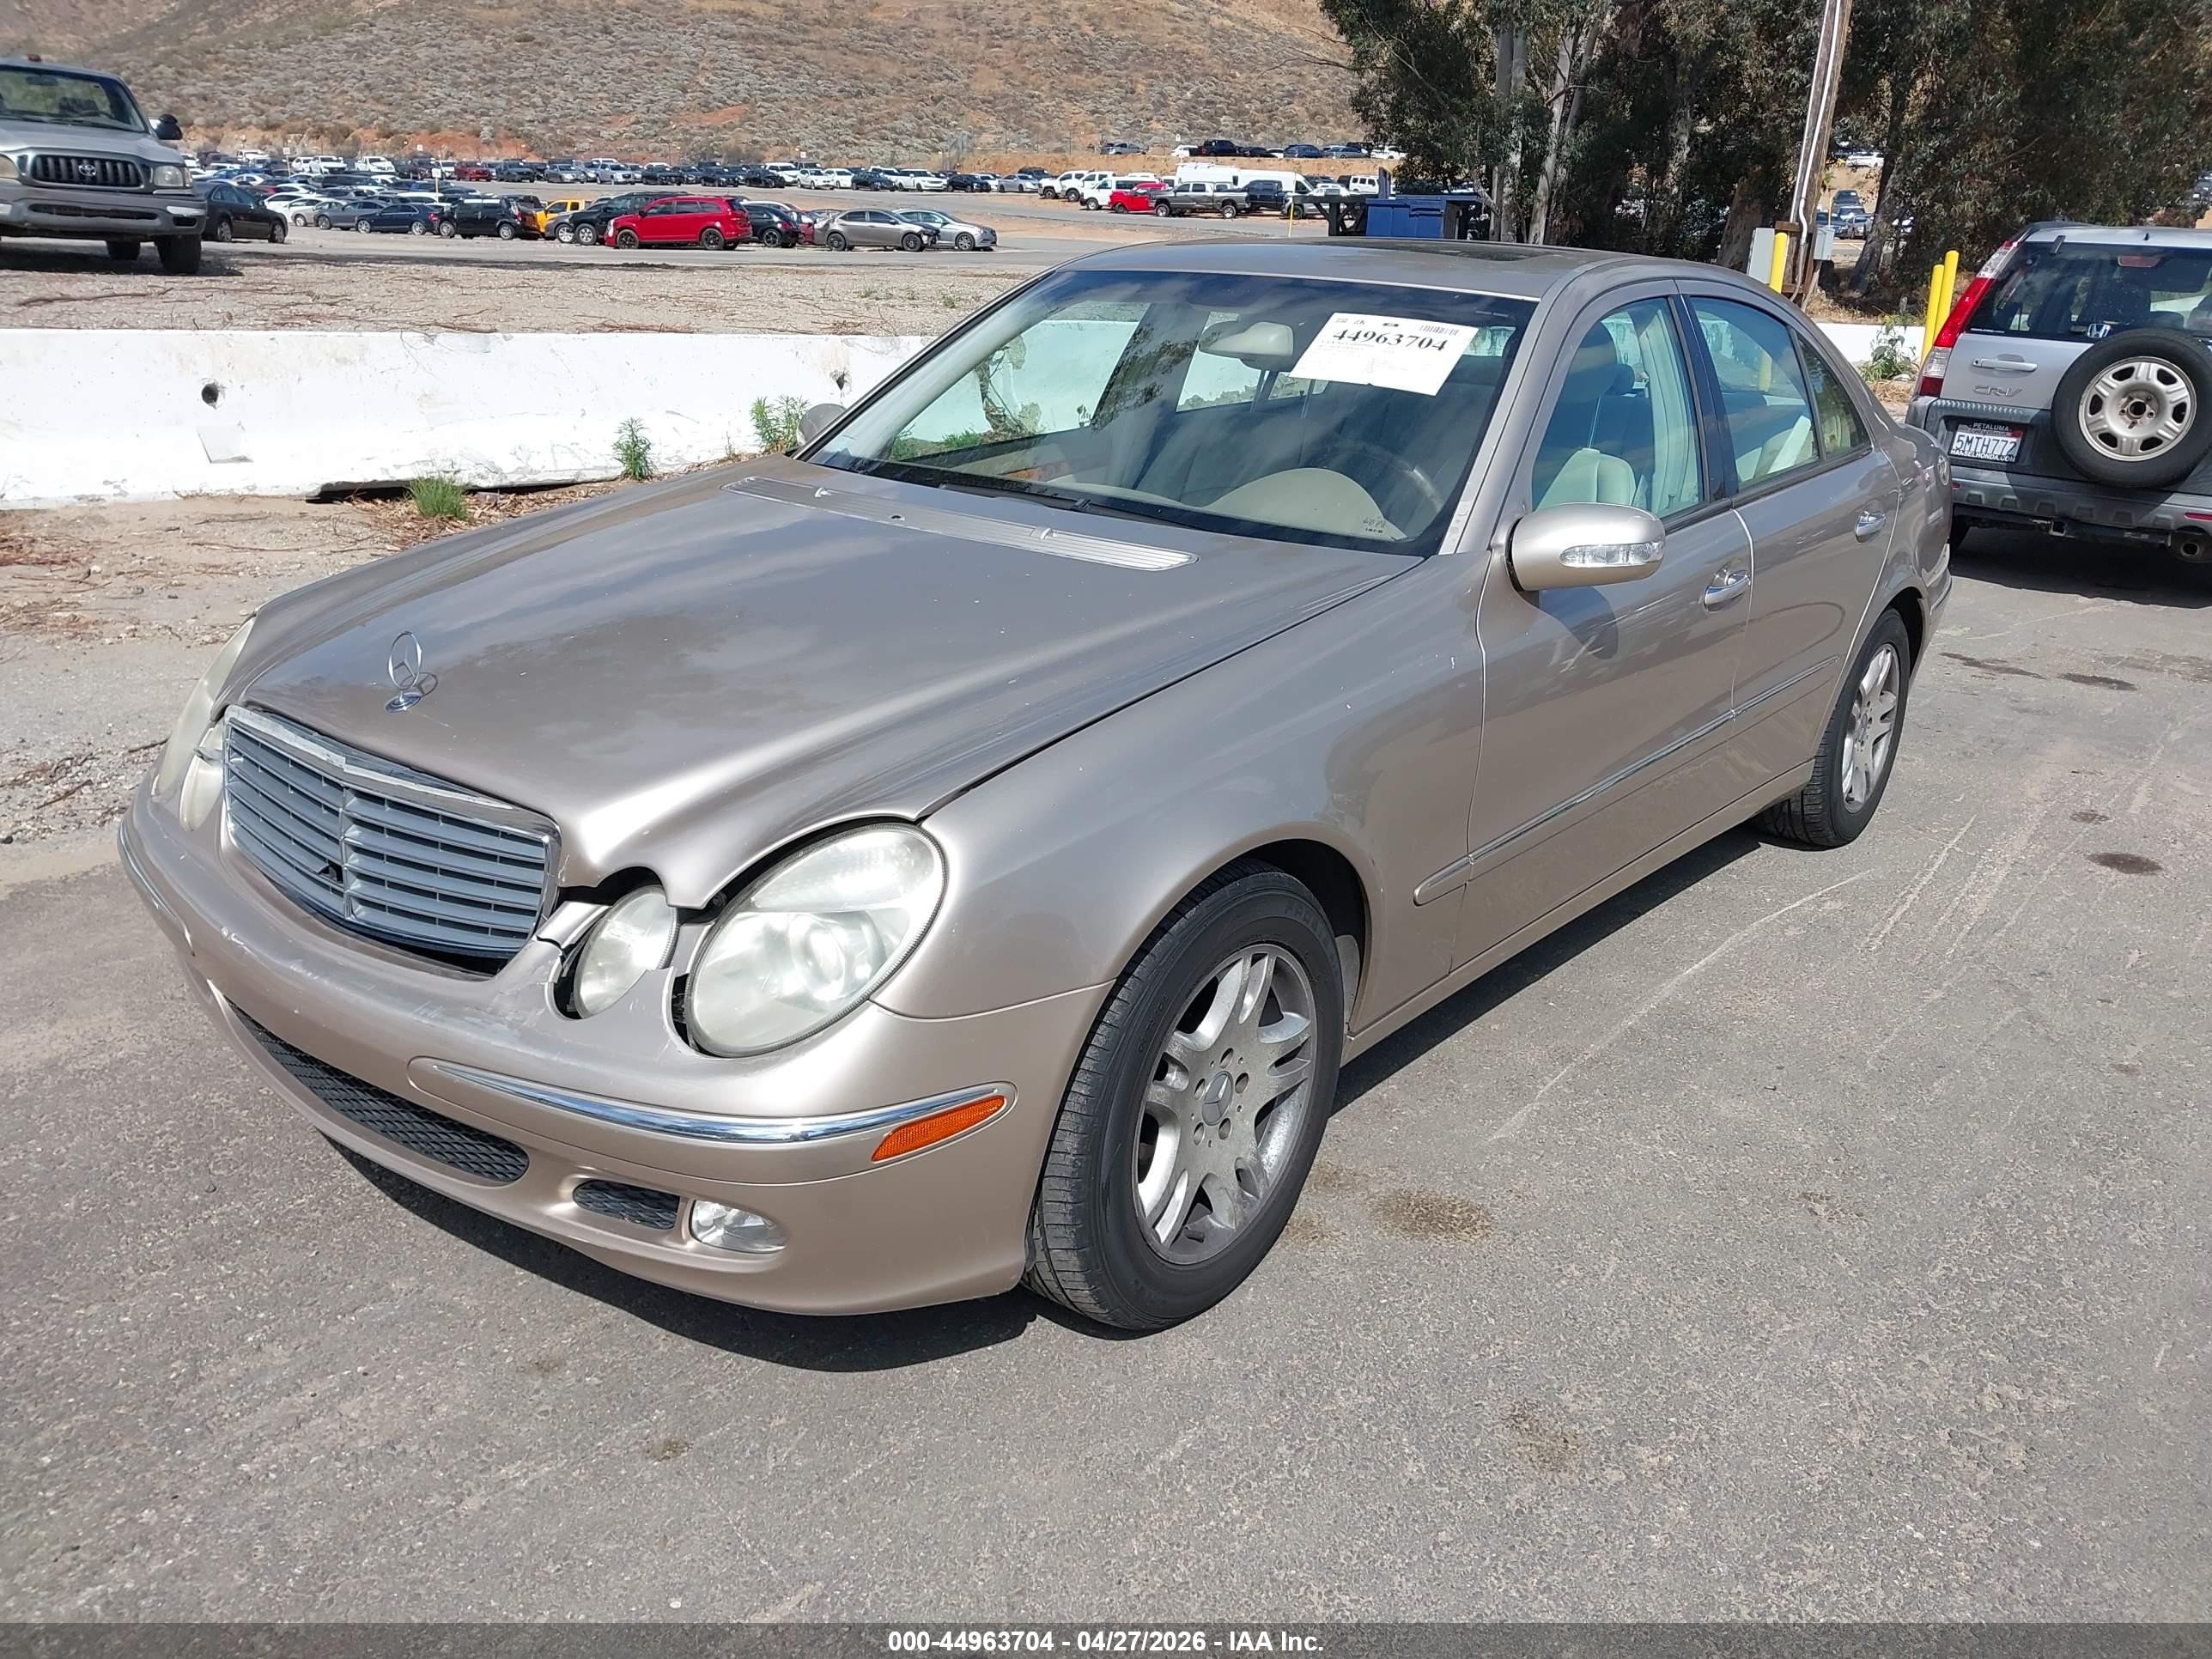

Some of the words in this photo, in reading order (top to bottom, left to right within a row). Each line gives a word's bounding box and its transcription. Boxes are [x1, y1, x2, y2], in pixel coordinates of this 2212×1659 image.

[1333, 329, 1448, 351] 44963704
[1972, 422, 2010, 431] PETALUMA
[1956, 434, 2017, 458] 5MTH772
